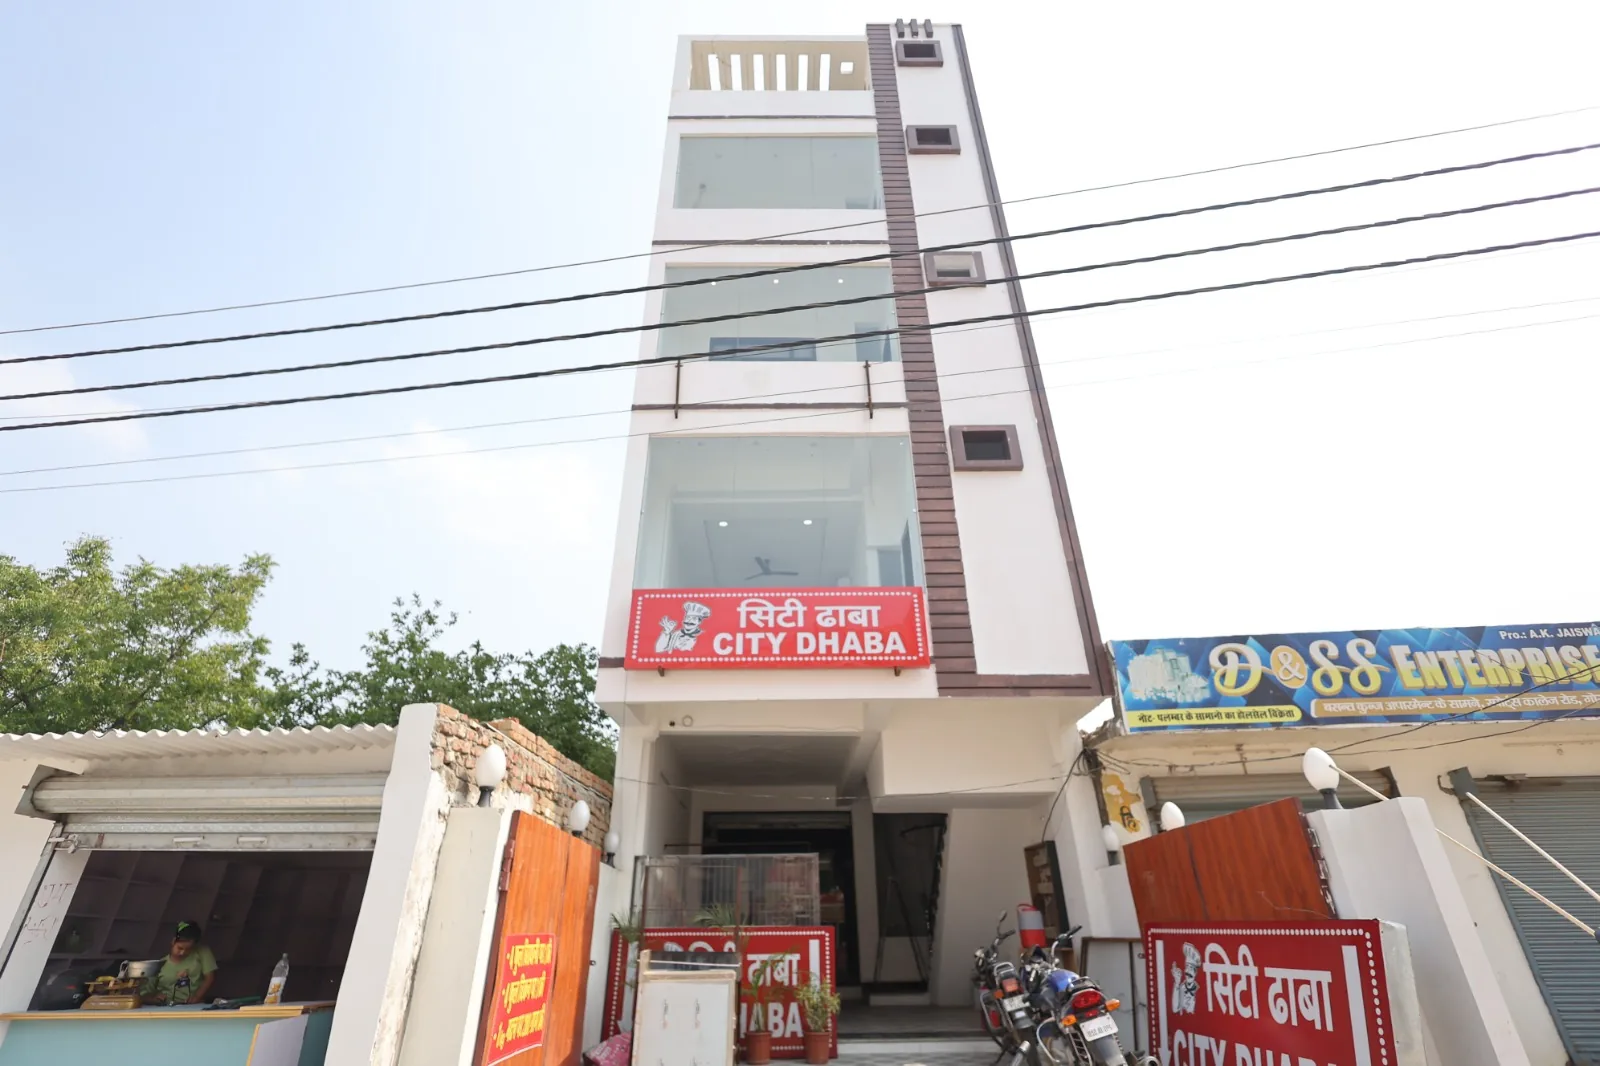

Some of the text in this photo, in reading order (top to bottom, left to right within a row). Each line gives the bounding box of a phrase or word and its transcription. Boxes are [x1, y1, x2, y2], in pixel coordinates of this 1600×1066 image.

[737, 598, 881, 628] सिटी ढाबा
[712, 631, 906, 656] CITY DHABA
[1530, 629, 1553, 639] A.K.
[1277, 651, 1305, 681] &
[1202, 942, 1334, 1032] सिटी ढाबा
